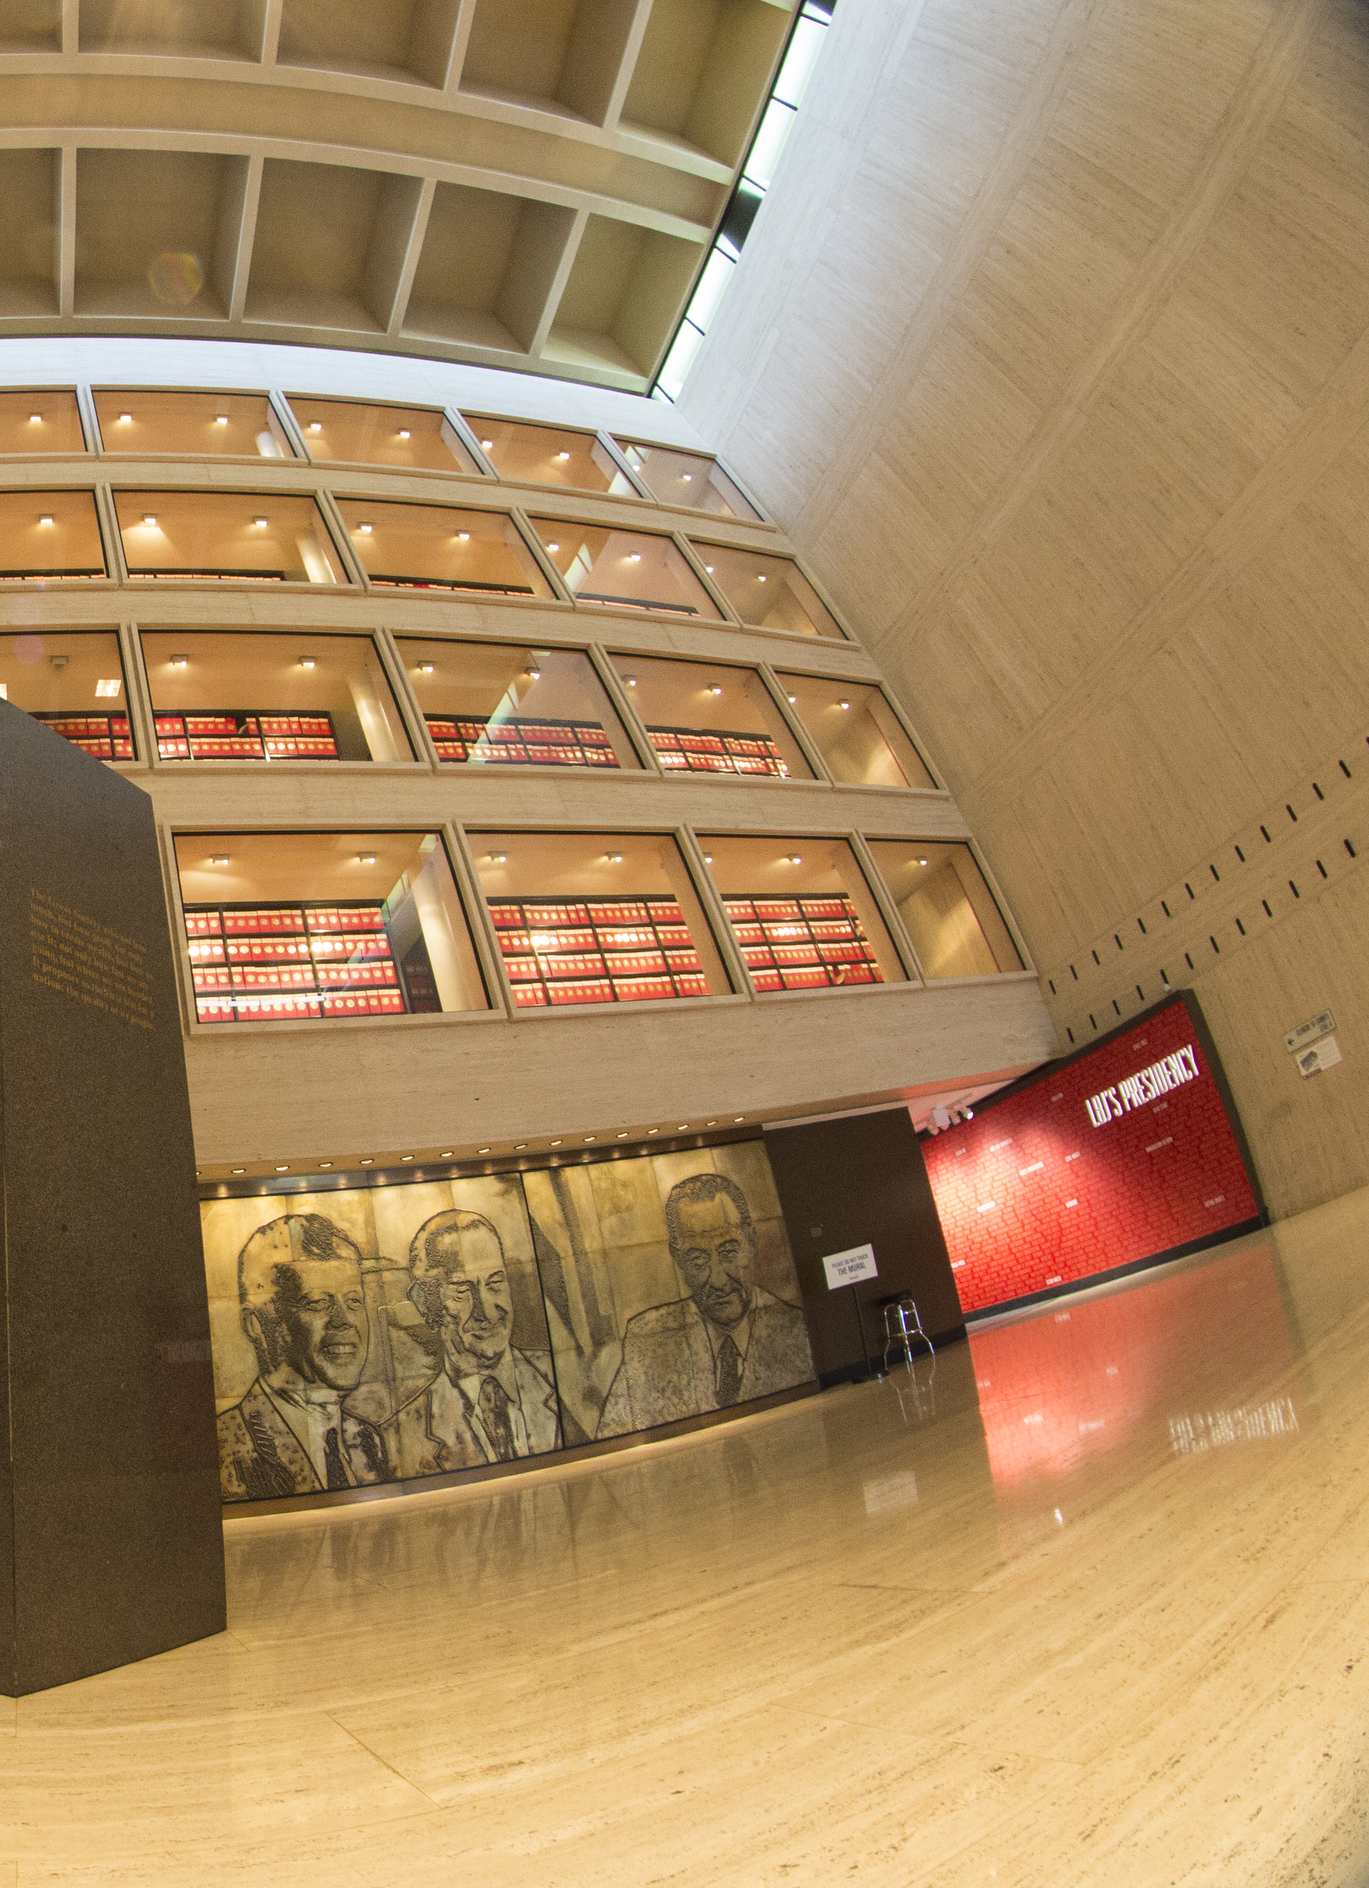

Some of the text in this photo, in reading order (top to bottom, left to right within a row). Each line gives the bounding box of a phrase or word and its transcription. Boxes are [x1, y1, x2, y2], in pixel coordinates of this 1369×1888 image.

[1085, 1044, 1200, 1128] LBJ'S PRESIDENCY
[837, 1261, 866, 1276] THE MURAL
